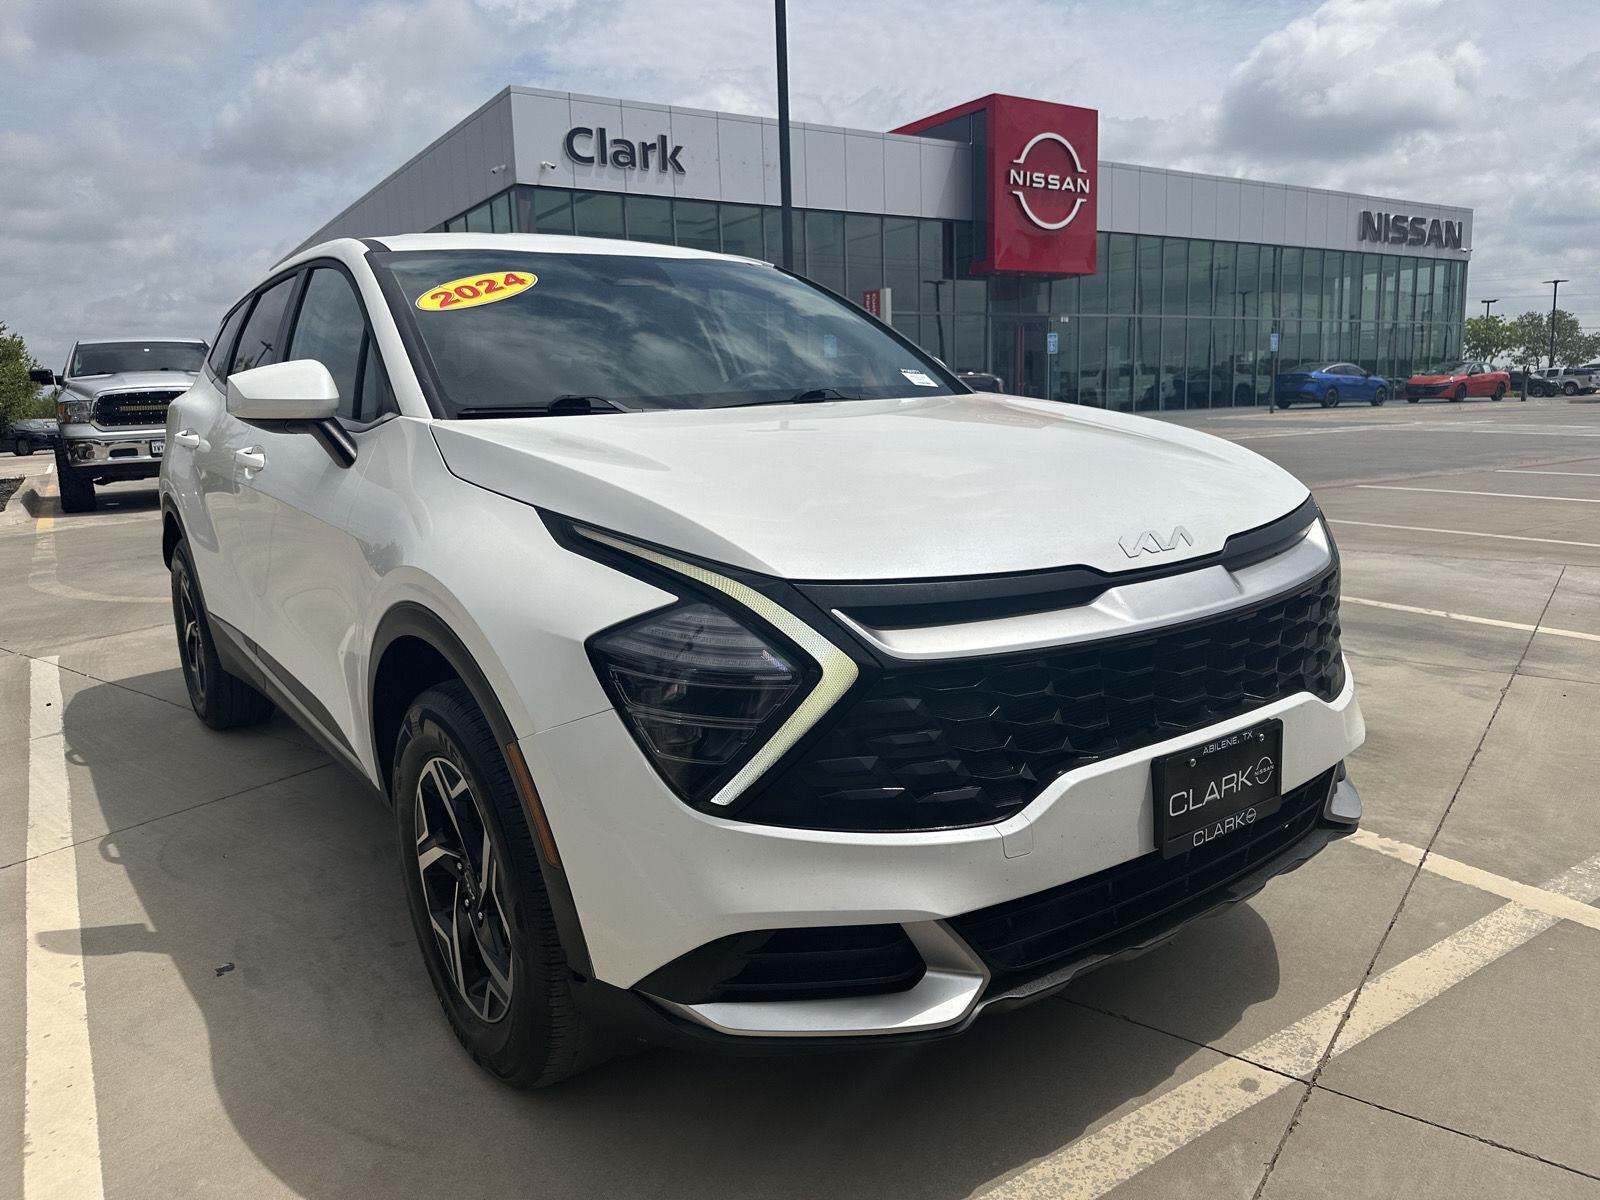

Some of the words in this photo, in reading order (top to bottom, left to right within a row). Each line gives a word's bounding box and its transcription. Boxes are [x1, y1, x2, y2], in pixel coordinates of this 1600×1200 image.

[564, 126, 687, 174] Clark
[1010, 168, 1090, 194] NISSAN
[1358, 210, 1463, 249] NISSAN
[430, 272, 527, 308] 2024
[1203, 737, 1240, 755] ABILENE,
[1242, 731, 1254, 741] TX
[1169, 765, 1253, 817] CLARK
[1193, 812, 1246, 847] CLARK
